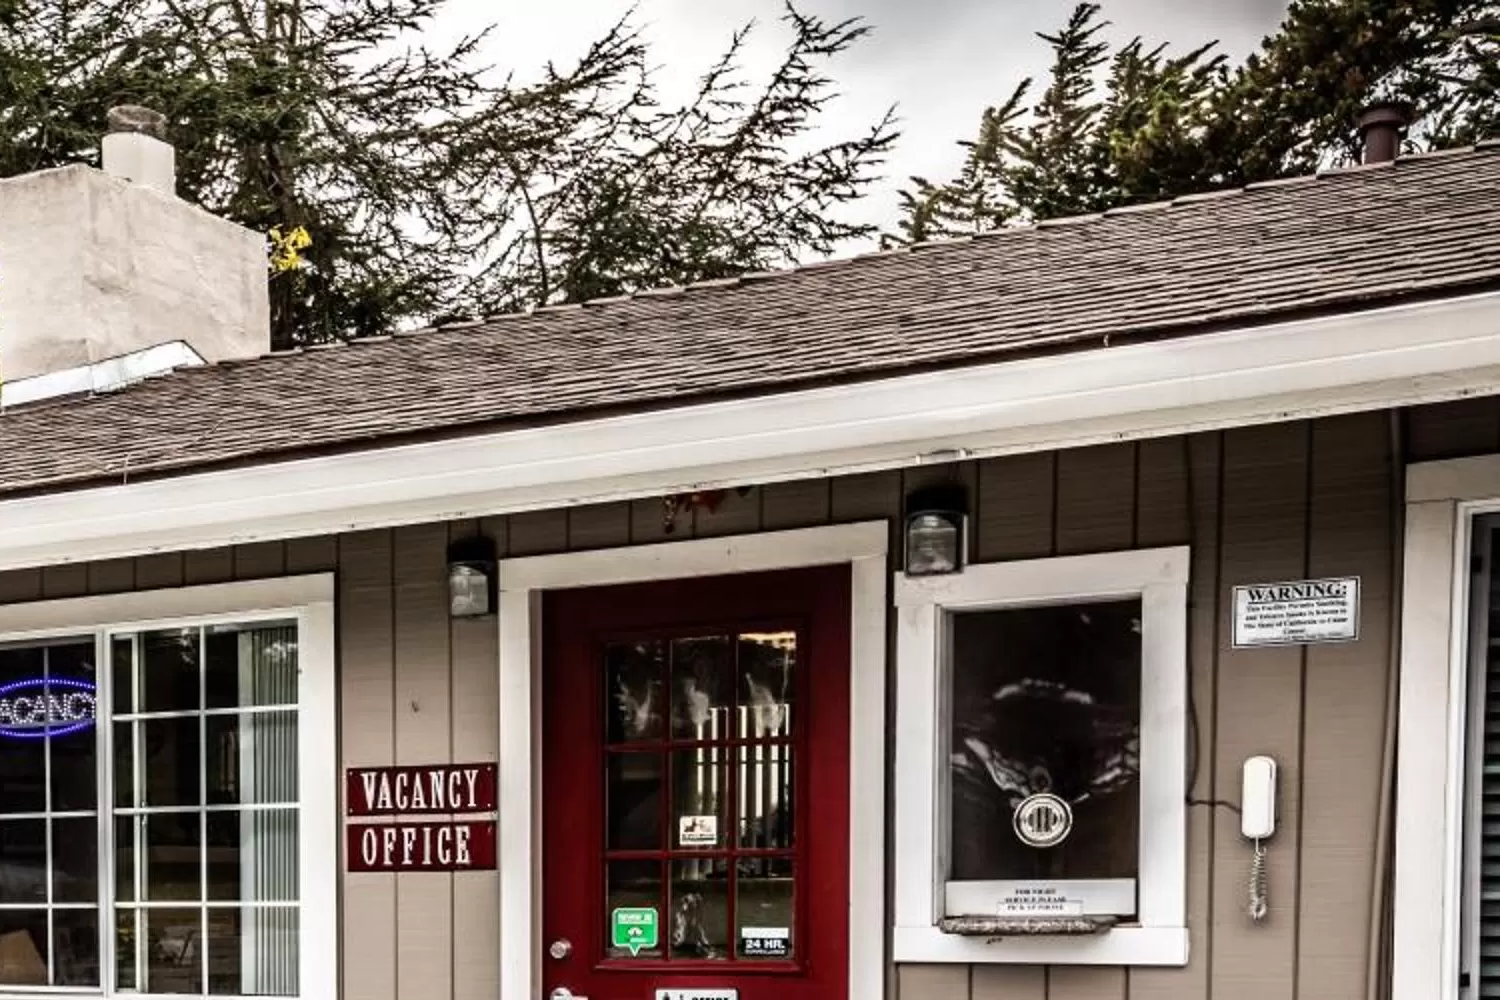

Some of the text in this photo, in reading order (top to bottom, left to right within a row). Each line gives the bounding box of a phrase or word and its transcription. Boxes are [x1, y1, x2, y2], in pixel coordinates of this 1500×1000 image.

[1247, 584, 1347, 601] WARNING:
[360, 769, 479, 810] VACANCY
[362, 825, 471, 866] OFFICE
[745, 939, 761, 949] 24
